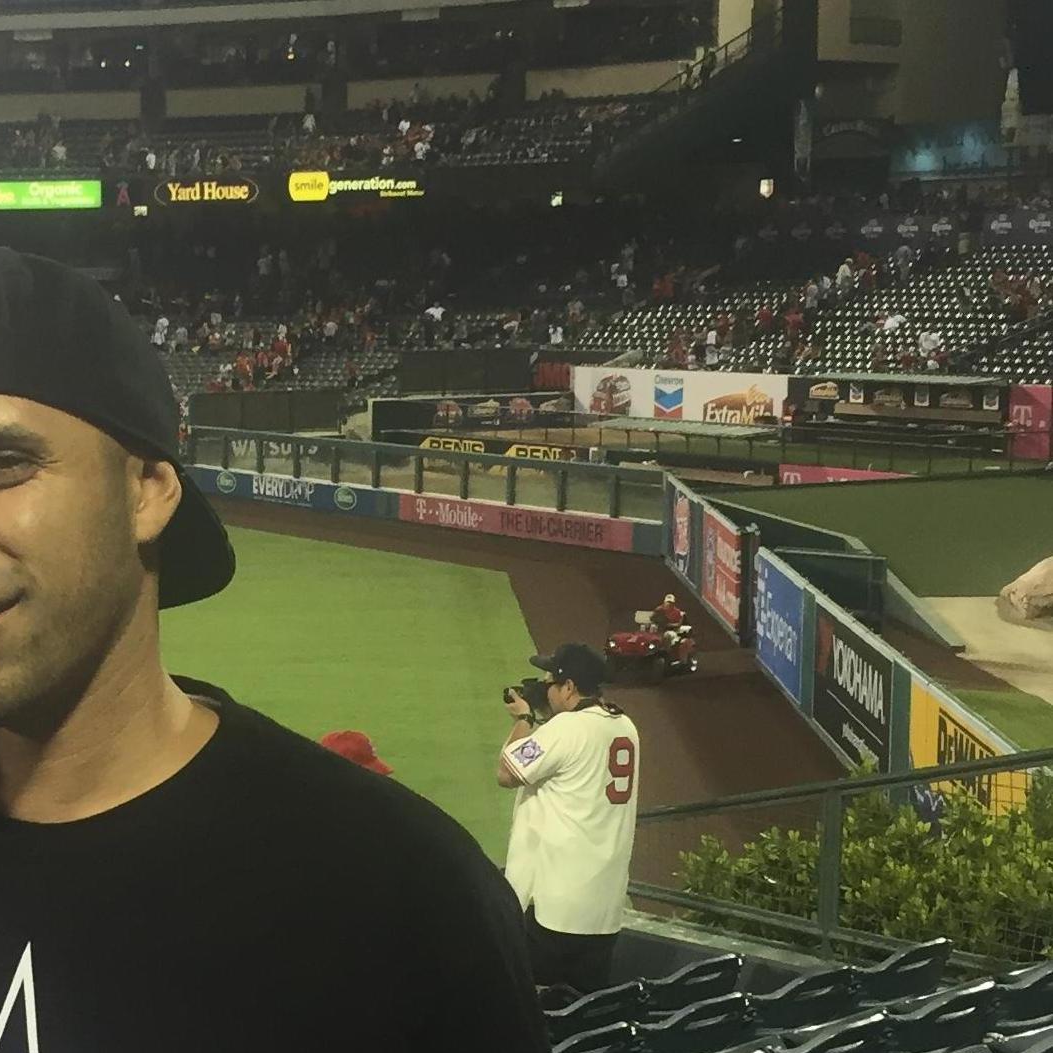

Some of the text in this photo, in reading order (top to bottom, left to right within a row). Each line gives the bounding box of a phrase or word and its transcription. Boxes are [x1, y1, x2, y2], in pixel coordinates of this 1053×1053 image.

[167, 181, 250, 202] Yard House
[294, 178, 325, 192] smile
[831, 634, 886, 725] YOKOHAMA
[605, 736, 635, 805] 9
